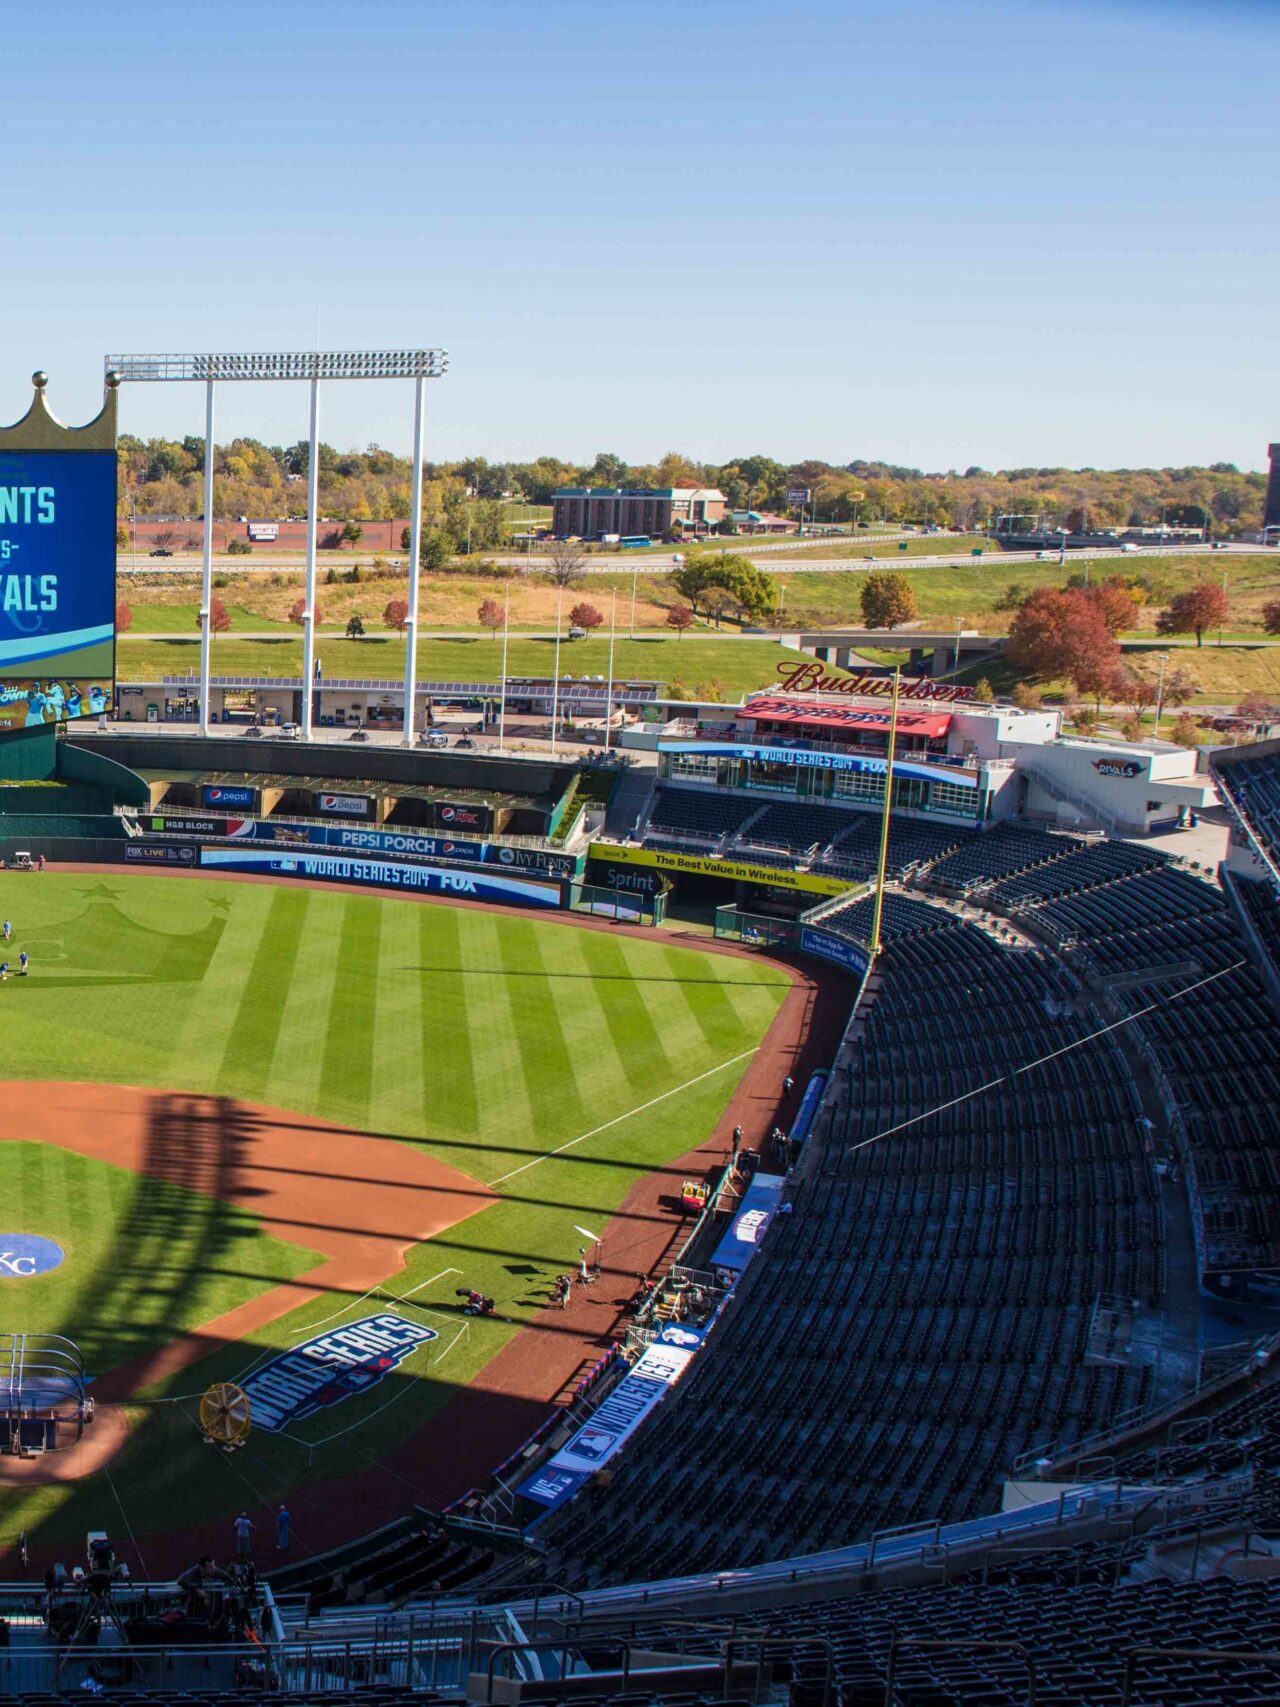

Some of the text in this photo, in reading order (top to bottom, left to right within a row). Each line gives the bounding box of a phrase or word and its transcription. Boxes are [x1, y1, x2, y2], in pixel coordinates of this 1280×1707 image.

[777, 661, 974, 701] Budweiser
[760, 750, 887, 773] WORLD SERIES 2014 FOX
[1099, 764, 1133, 776] RIVALS
[223, 792, 248, 802] pepsi
[751, 782, 782, 792] Commerce
[337, 800, 362, 810] pepsi
[166, 821, 214, 831] H&R BLOCK
[143, 849, 165, 857] LIVE
[341, 831, 436, 854] PEPSI PORCH
[455, 845, 474, 855] pepsi
[304, 861, 477, 893] WORLD SERIES 2014 FOX
[607, 869, 653, 891] Sprint
[655, 855, 800, 885] The Best Value in Wireless.
[230, 1315, 432, 1428] WORLD SERIES
[586, 1360, 676, 1434] WORLD SERIES
[528, 1478, 564, 1500] WS
